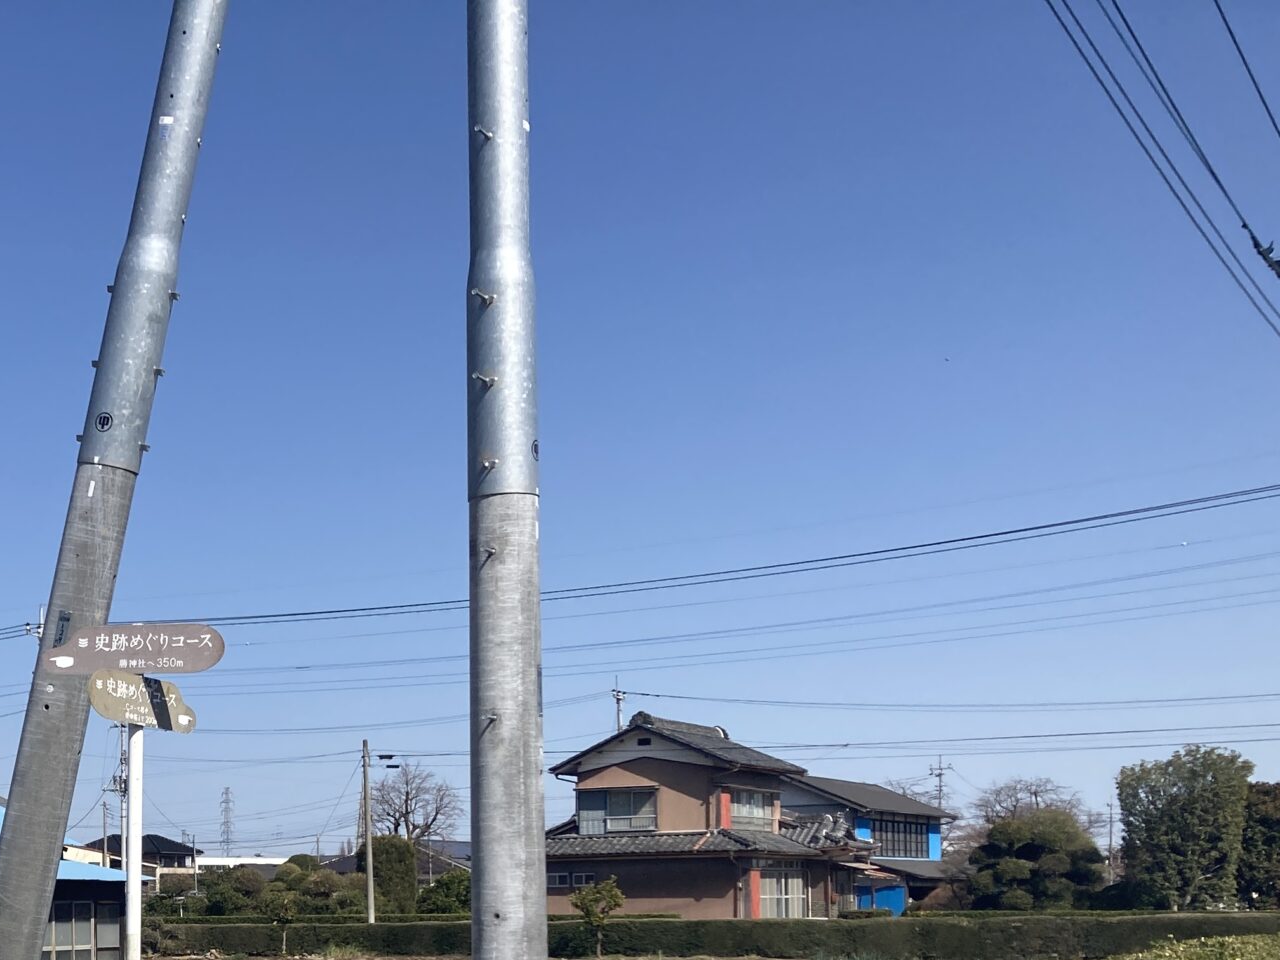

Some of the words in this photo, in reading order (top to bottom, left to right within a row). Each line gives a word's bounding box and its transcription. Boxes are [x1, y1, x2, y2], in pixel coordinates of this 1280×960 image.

[94, 632, 213, 652] 史跡めぐりコース
